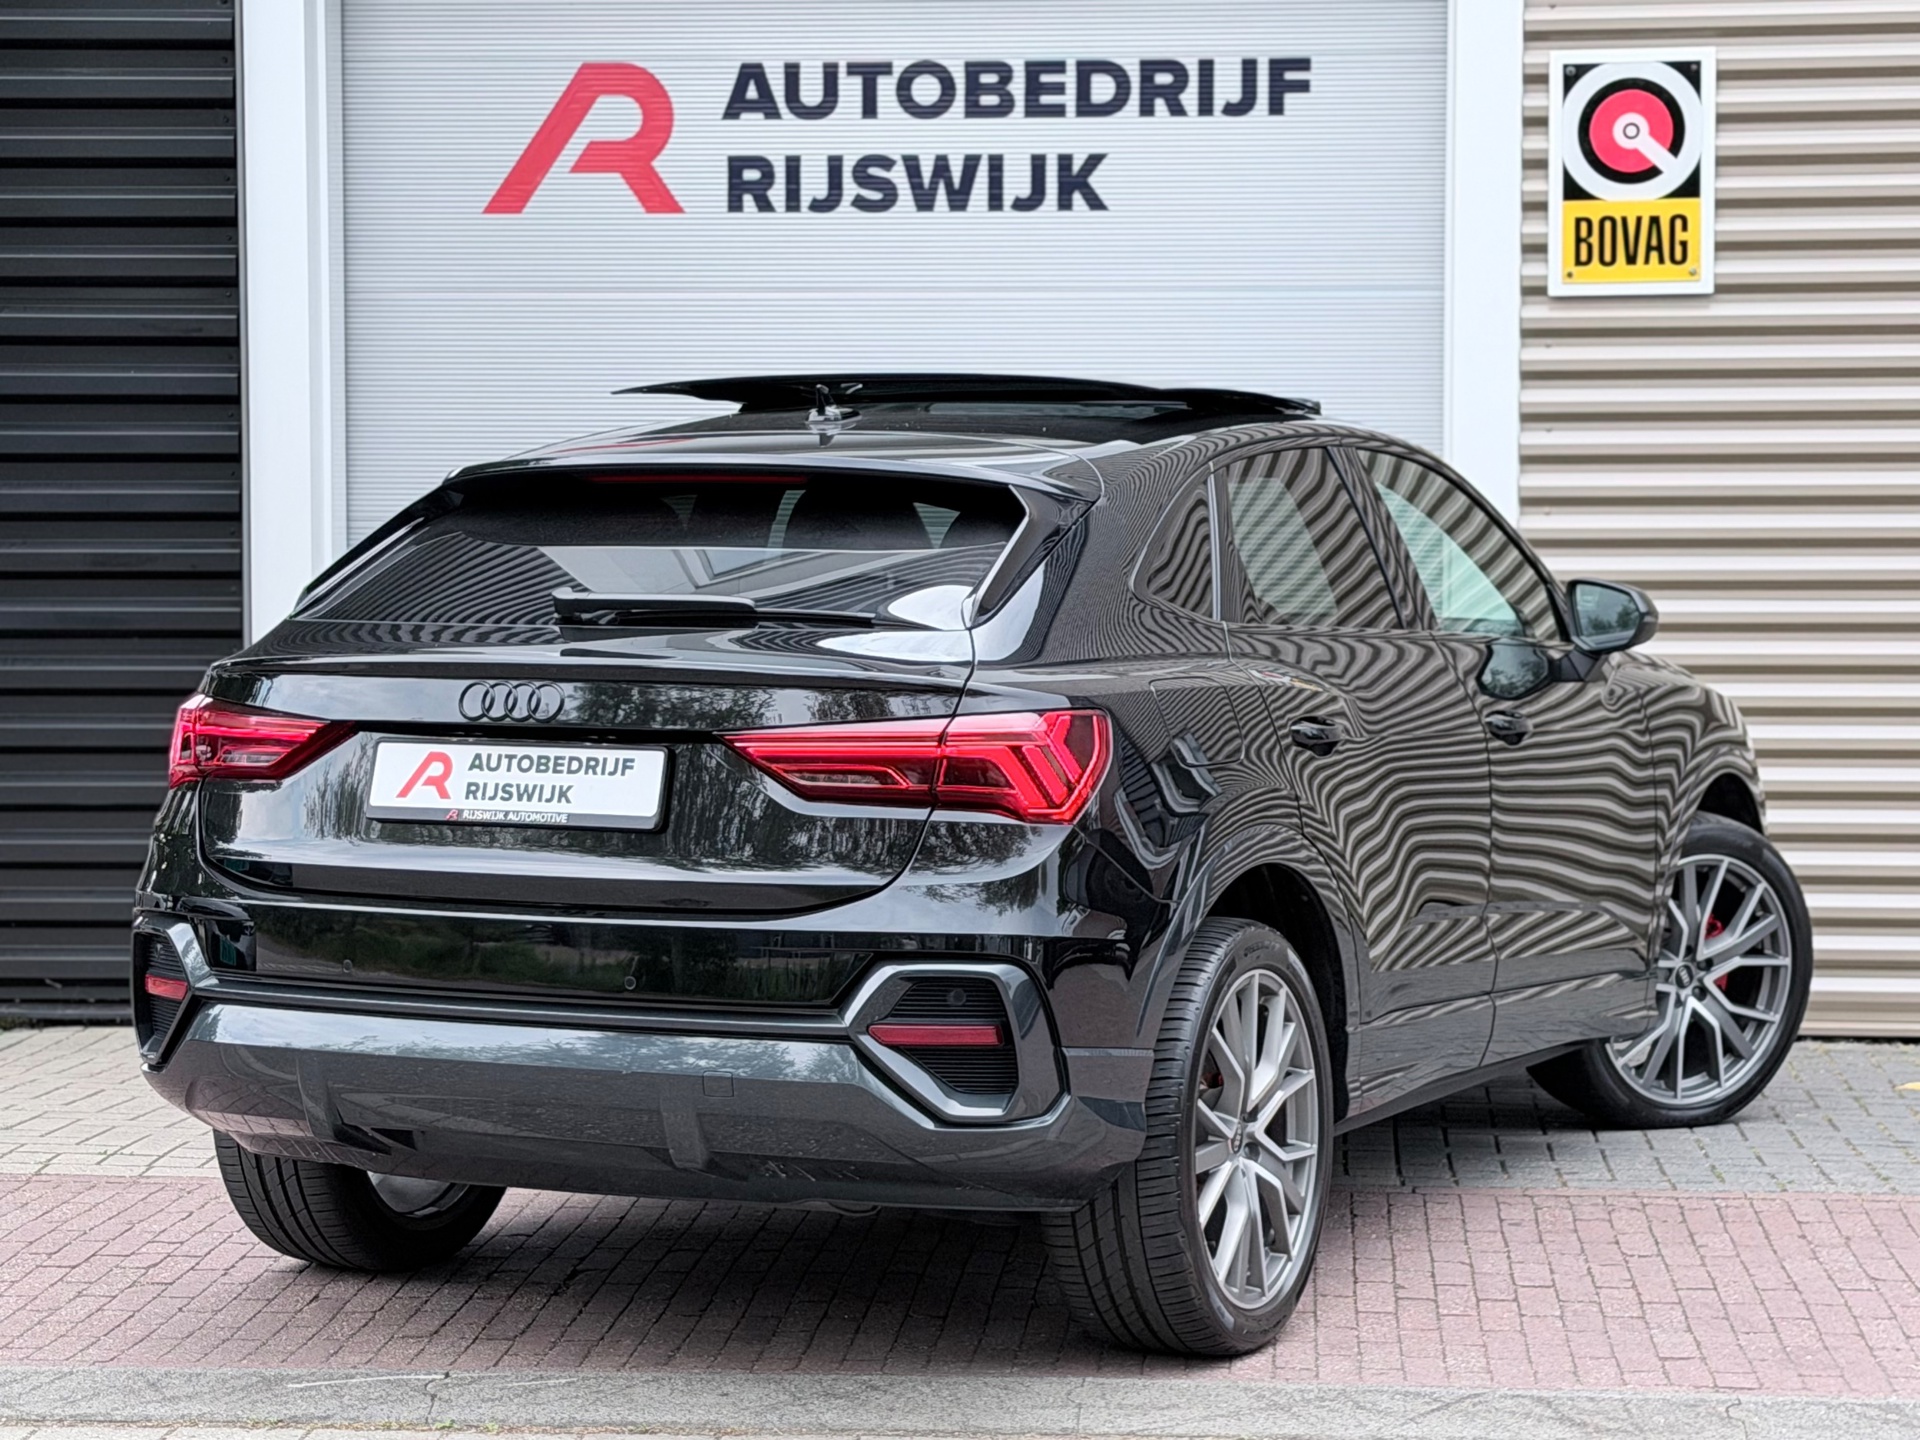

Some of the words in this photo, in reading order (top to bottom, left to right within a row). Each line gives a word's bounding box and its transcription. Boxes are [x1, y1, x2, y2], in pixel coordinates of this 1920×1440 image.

[722, 57, 1312, 120] AUTOBEDRIJF
[726, 153, 1109, 214] RIJSWIJK
[1574, 214, 1688, 267] BOVAG
[468, 753, 635, 776] AUTOBEDRIJF
[465, 782, 574, 804] RIJSWIJK
[462, 809, 506, 821] RIJSWIJK
[507, 812, 568, 823] AUTOMOTIVE
